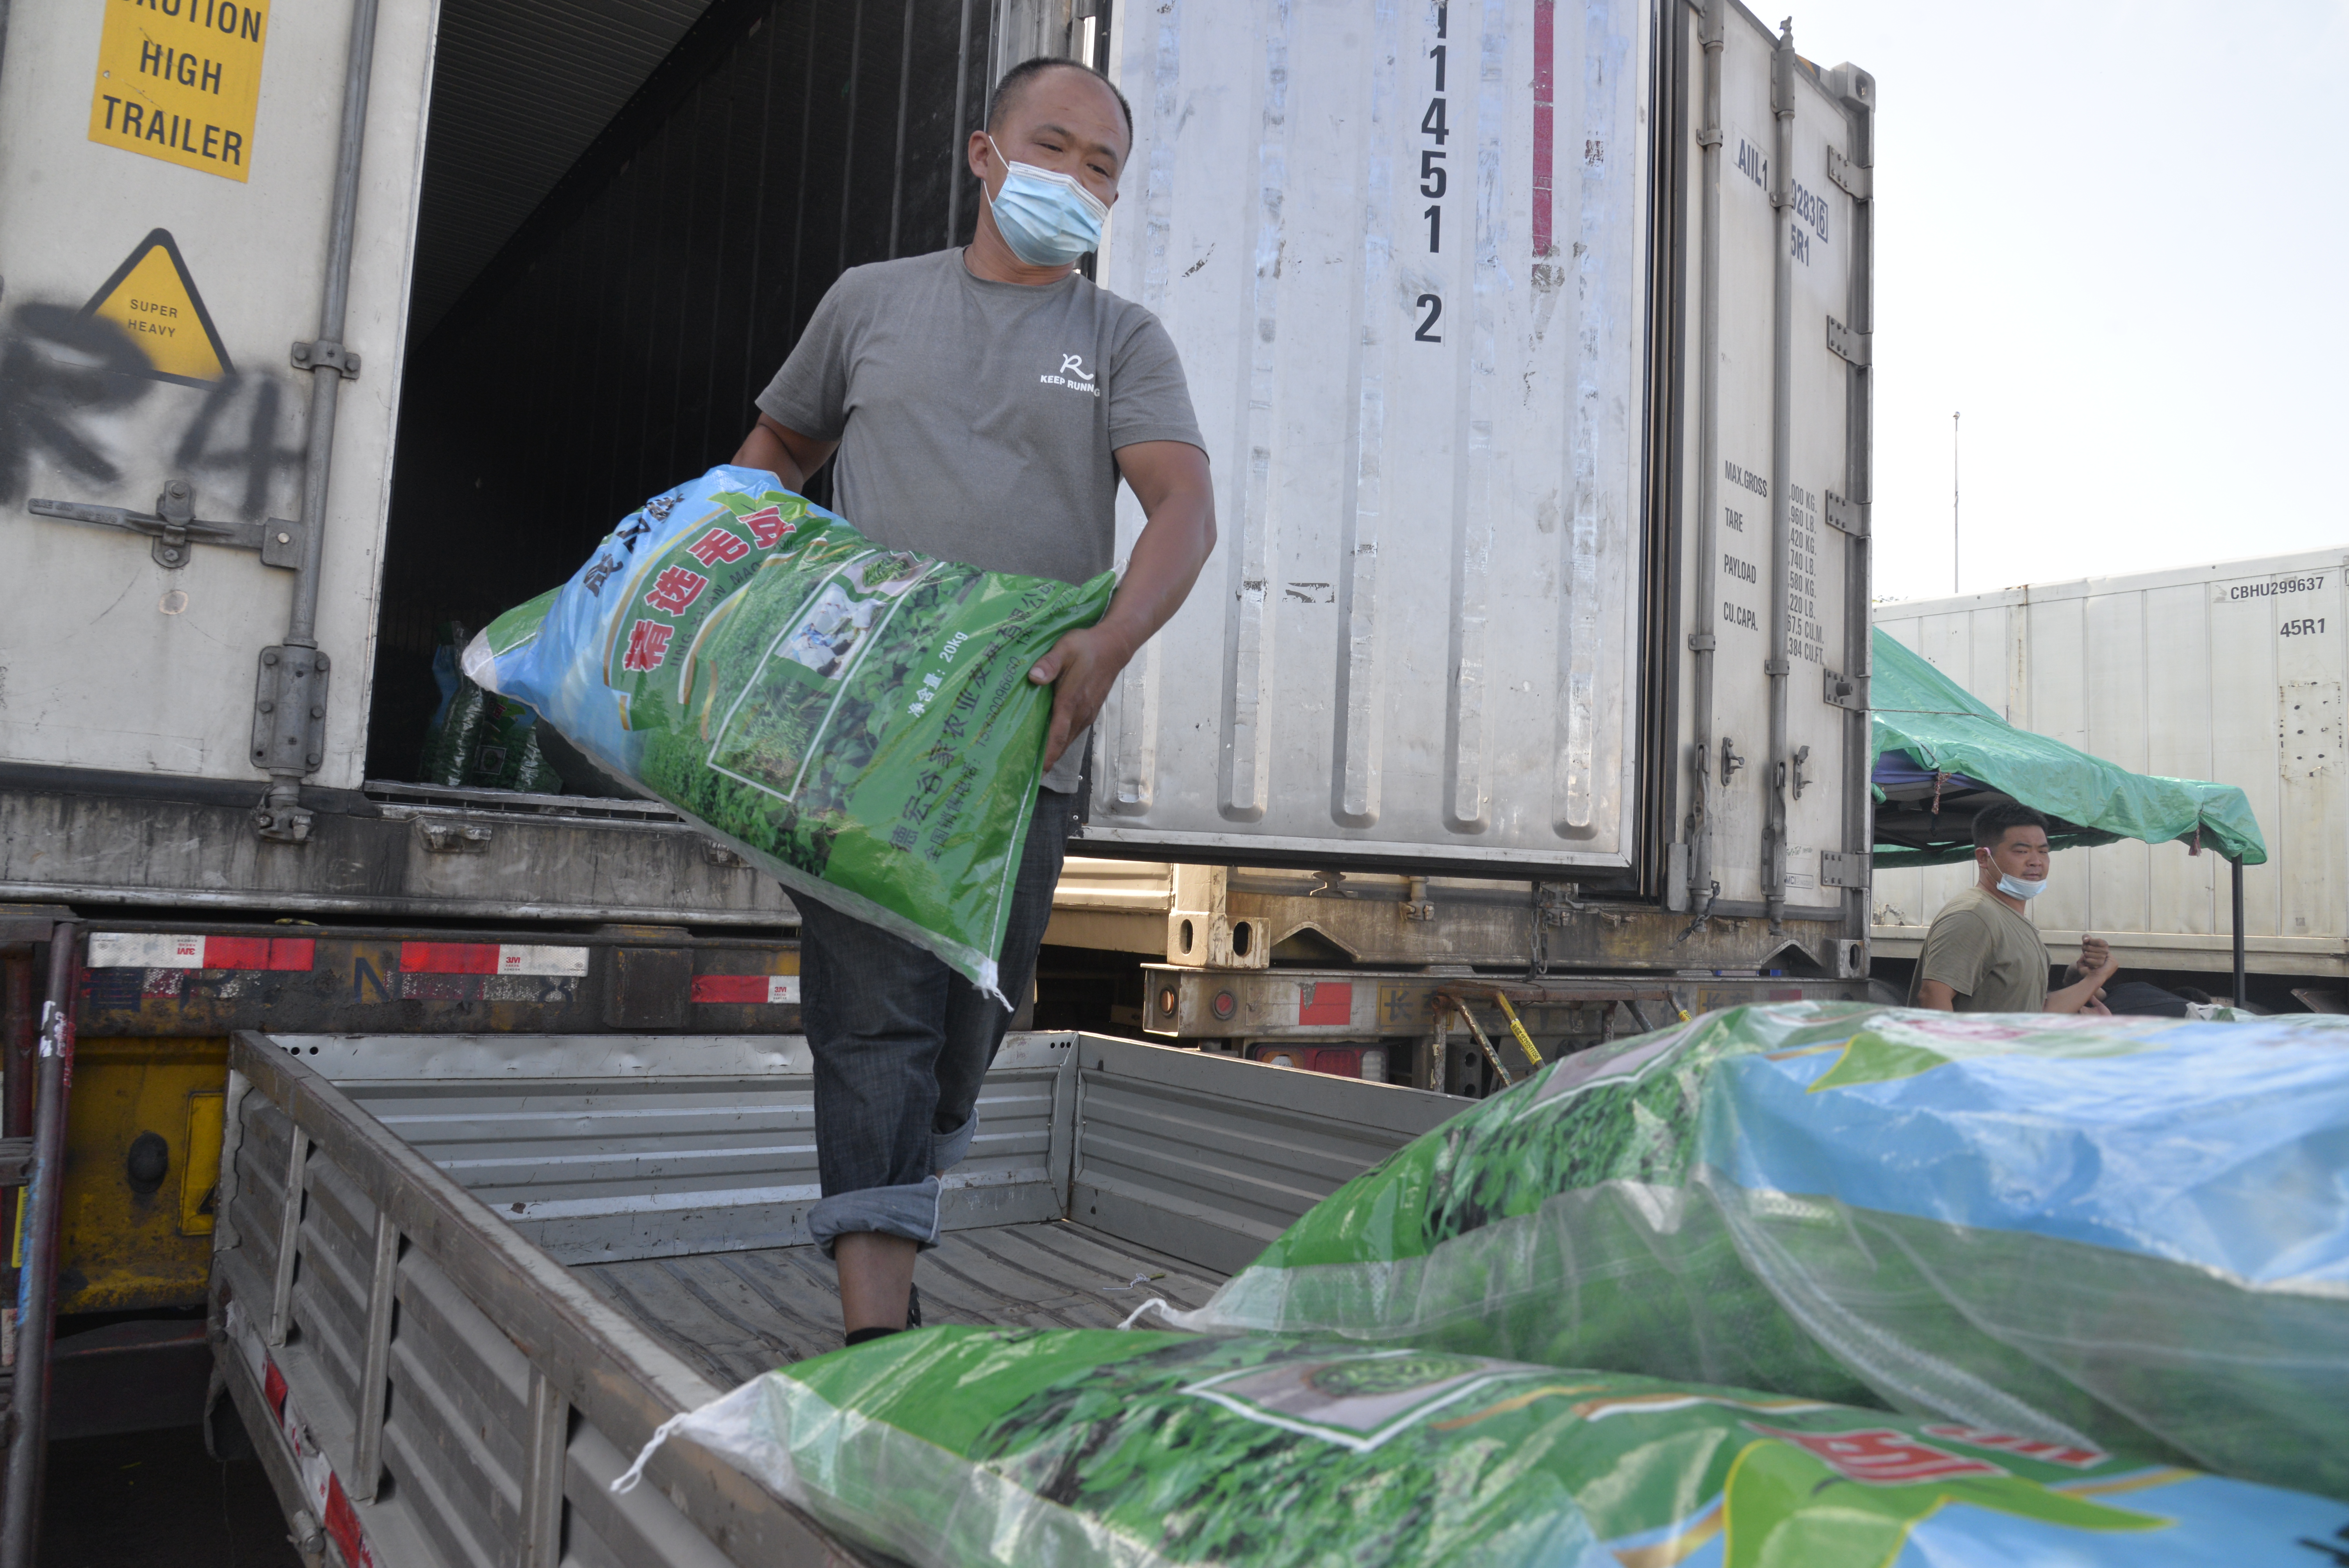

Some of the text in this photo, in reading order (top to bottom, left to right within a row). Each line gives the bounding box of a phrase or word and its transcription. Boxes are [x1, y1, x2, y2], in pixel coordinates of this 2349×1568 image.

[140, 40, 222, 95] HIGH
[103, 94, 242, 166] TRAILER
[130, 299, 178, 318] SUPER
[1415, 294, 1442, 343] 2
[128, 319, 175, 337] HEAVY
[1041, 375, 1100, 397] KEEP RUNNG
[1725, 460, 1767, 497] MAX.GROSS
[1806, 492, 1817, 513] KG.
[1725, 507, 1743, 533] TARE
[1805, 535, 1816, 556] KG.
[1805, 513, 1816, 534] LB.
[1724, 554, 1756, 584] PAYLOAD
[1805, 577, 1816, 598] KG.
[1805, 556, 1816, 577] LB.
[622, 506, 797, 672] 精选毛豆
[2231, 577, 2324, 600] CBHU299637
[1723, 601, 1758, 631] CU.CAPA.
[1805, 599, 1816, 620] LB.
[2280, 618, 2325, 637] 45R1
[670, 632, 694, 671] JING
[939, 631, 969, 663] 20kg
[888, 583, 1056, 854] 德宏谷家农业发展有限公司
[177, 947, 196, 955] 3M
